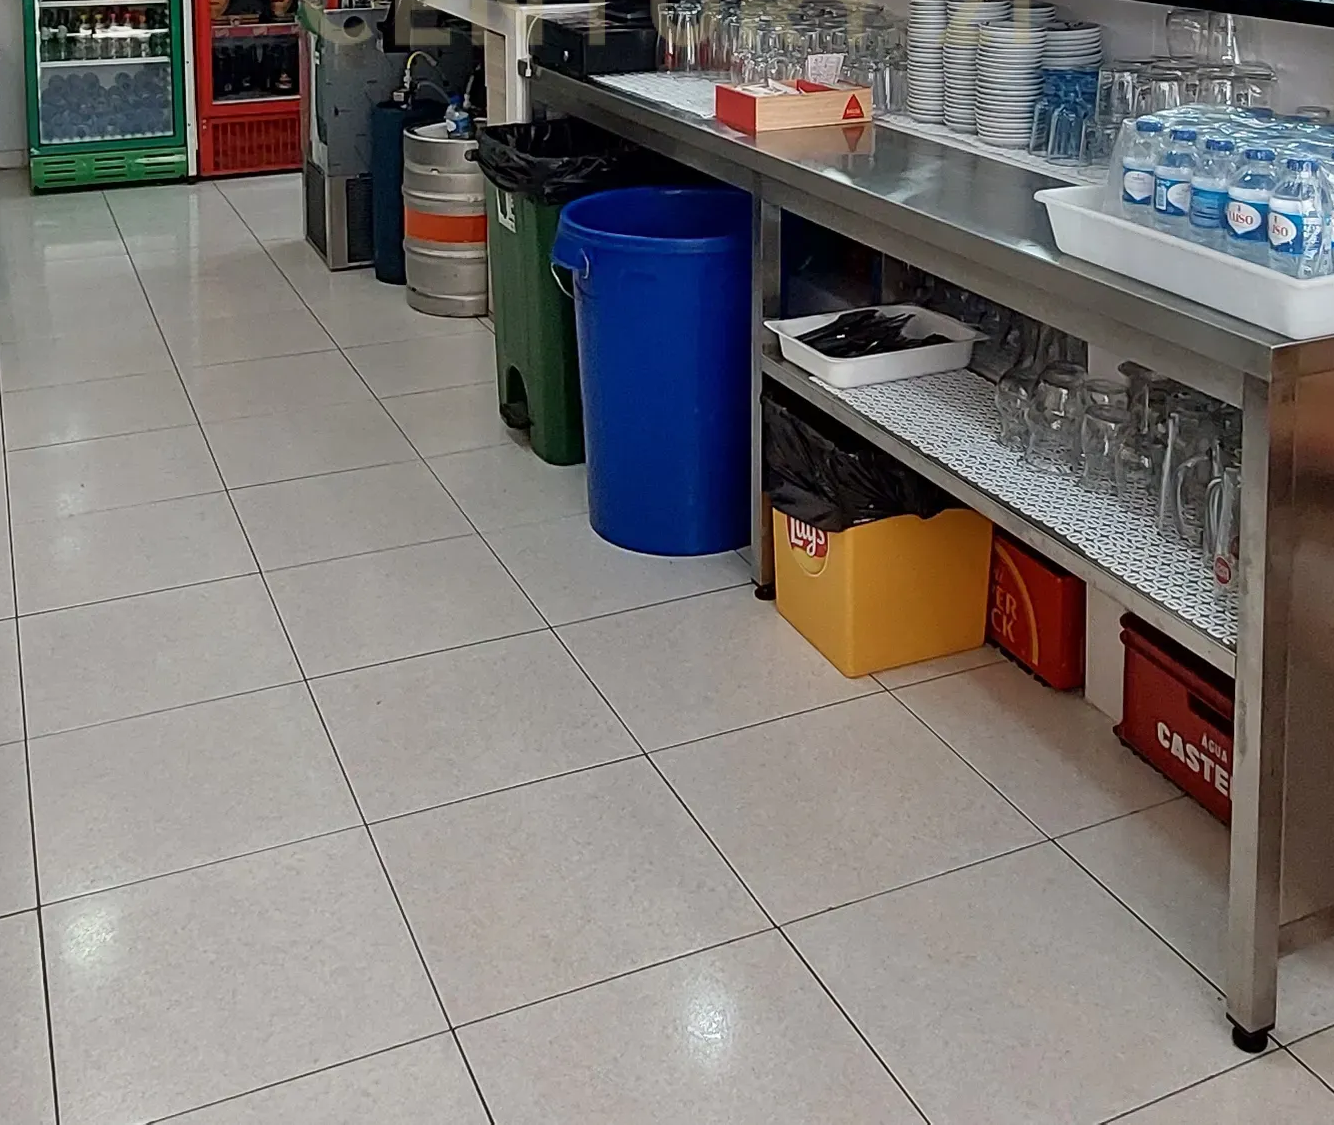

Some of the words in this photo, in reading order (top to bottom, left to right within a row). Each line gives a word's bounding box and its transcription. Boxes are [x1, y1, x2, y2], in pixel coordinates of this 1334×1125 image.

[787, 516, 829, 558] Lays
[1156, 721, 1233, 798] CASTE
[1201, 733, 1228, 763] ÁGUA
